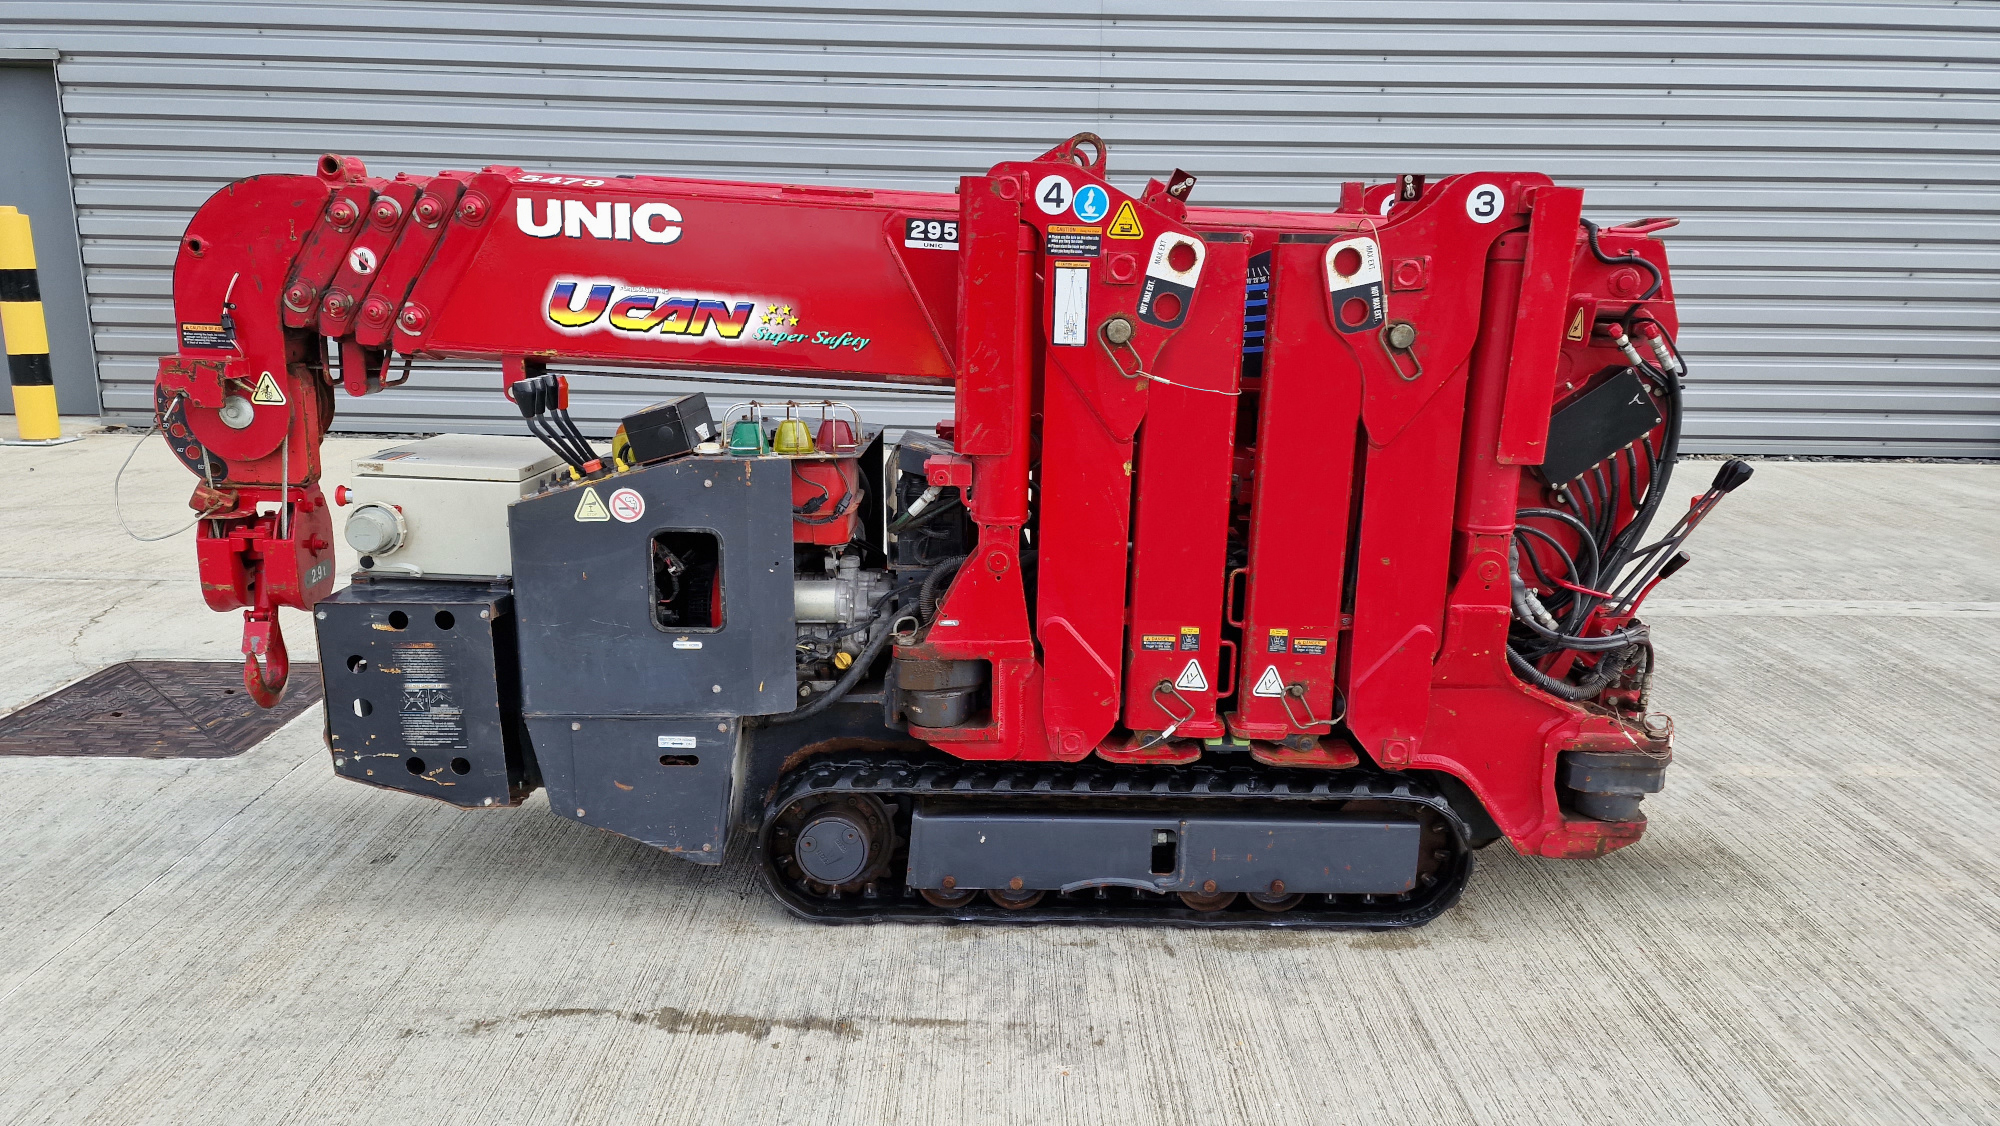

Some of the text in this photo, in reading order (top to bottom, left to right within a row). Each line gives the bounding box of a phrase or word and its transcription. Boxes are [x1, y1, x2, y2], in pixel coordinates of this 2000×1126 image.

[517, 174, 605, 187] 5479
[1043, 182, 1064, 208] 4
[1474, 190, 1496, 217] 3
[516, 197, 684, 245] UNIC
[910, 220, 958, 241] 295
[1154, 251, 1164, 266] MAX
[1366, 244, 1374, 259] MAX
[1142, 291, 1152, 304] MAX
[1370, 285, 1380, 297] NOT
[1139, 303, 1149, 315] NOT
[1372, 297, 1381, 310] MAX
[752, 326, 872, 353] Super Safety
